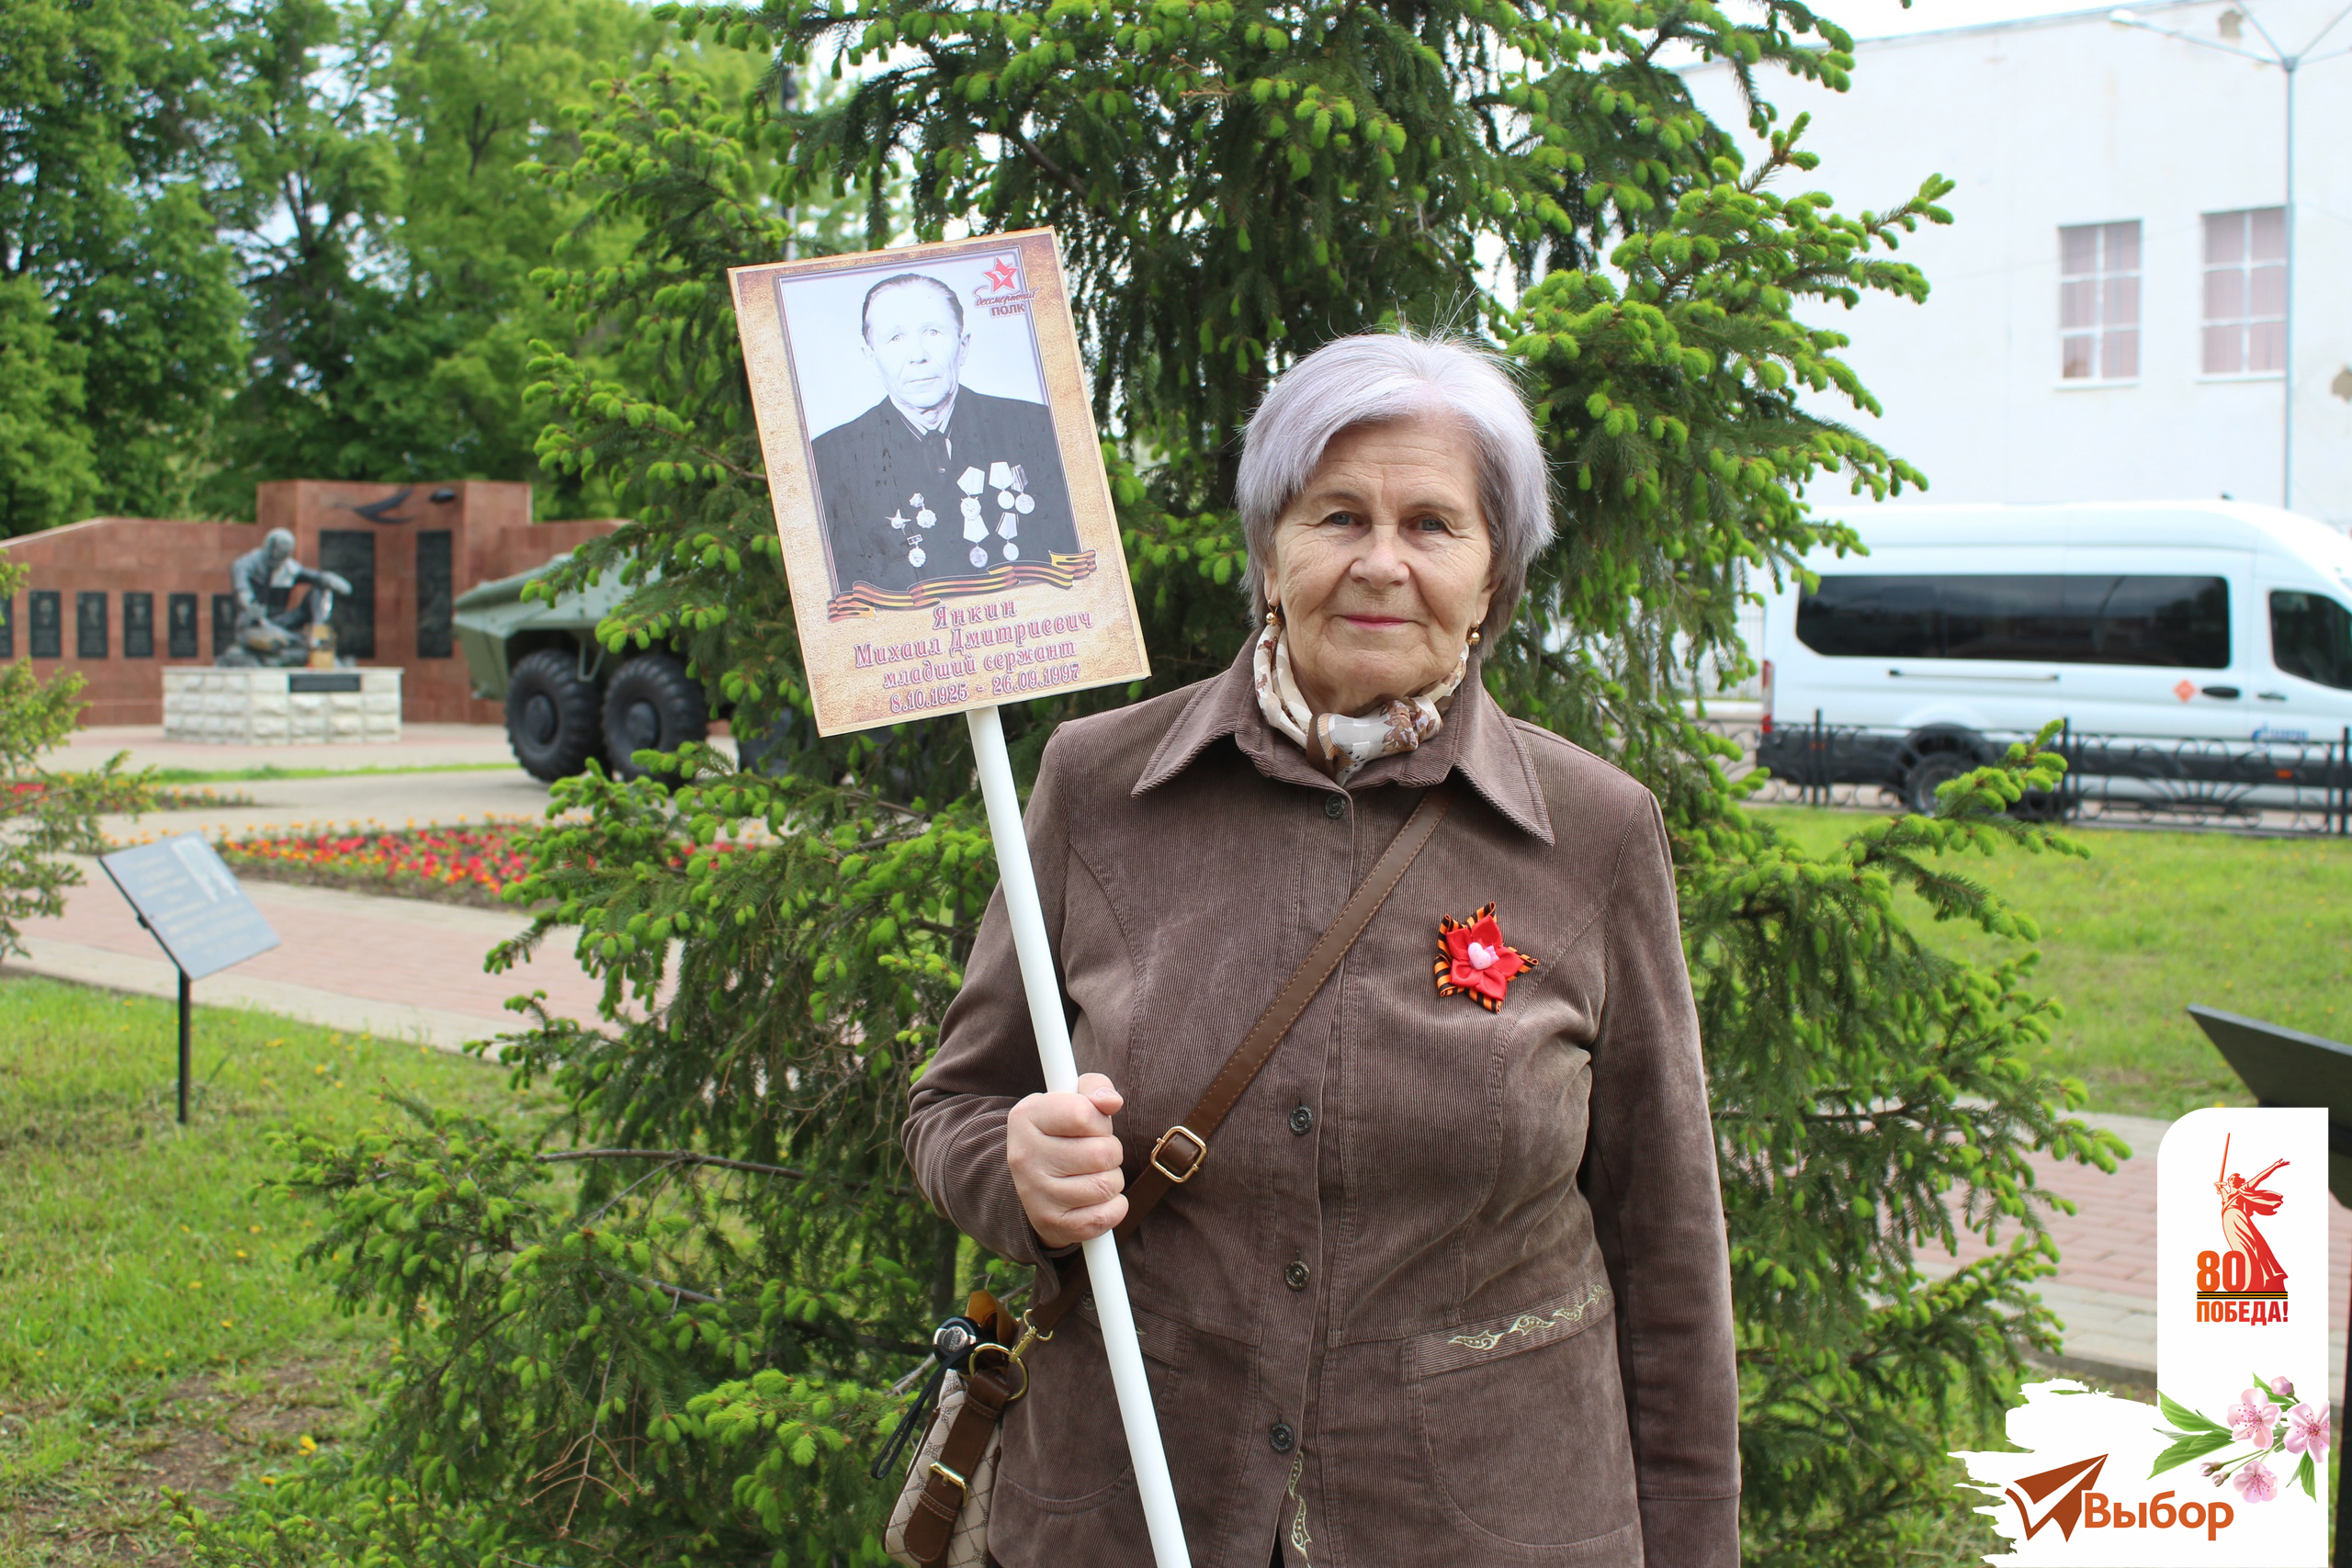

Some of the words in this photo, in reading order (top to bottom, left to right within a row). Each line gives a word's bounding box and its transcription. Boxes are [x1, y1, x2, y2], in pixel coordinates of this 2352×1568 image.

[991, 303, 1026, 316] ПОЛК
[933, 600, 1017, 629] Янкин
[854, 637, 942, 668] Михаил
[950, 612, 1092, 657] Дмитриевич
[884, 654, 977, 689] младший
[984, 642, 1077, 673] сержант
[890, 682, 968, 713] 8.10.1925
[992, 662, 1080, 695] 26.09.1997
